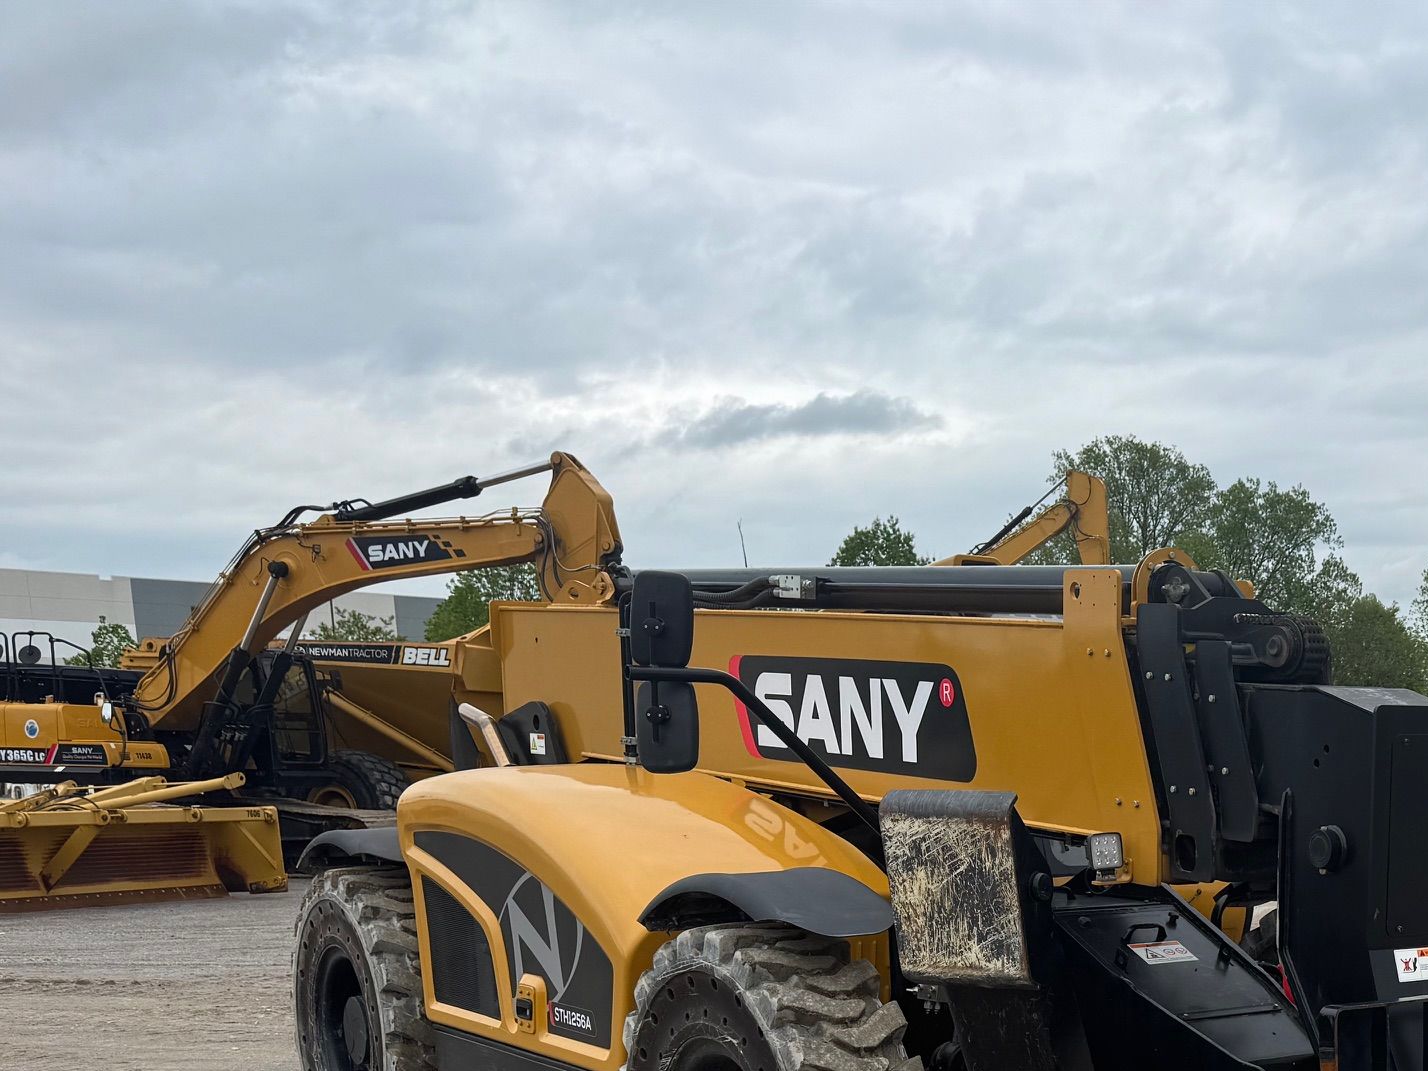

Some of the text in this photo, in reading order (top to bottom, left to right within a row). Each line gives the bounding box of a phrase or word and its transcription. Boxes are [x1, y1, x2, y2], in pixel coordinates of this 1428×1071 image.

[368, 540, 429, 562] SANY
[402, 647, 451, 666] BELL
[755, 672, 935, 763] SANY
[554, 1006, 592, 1031] STH1256A
